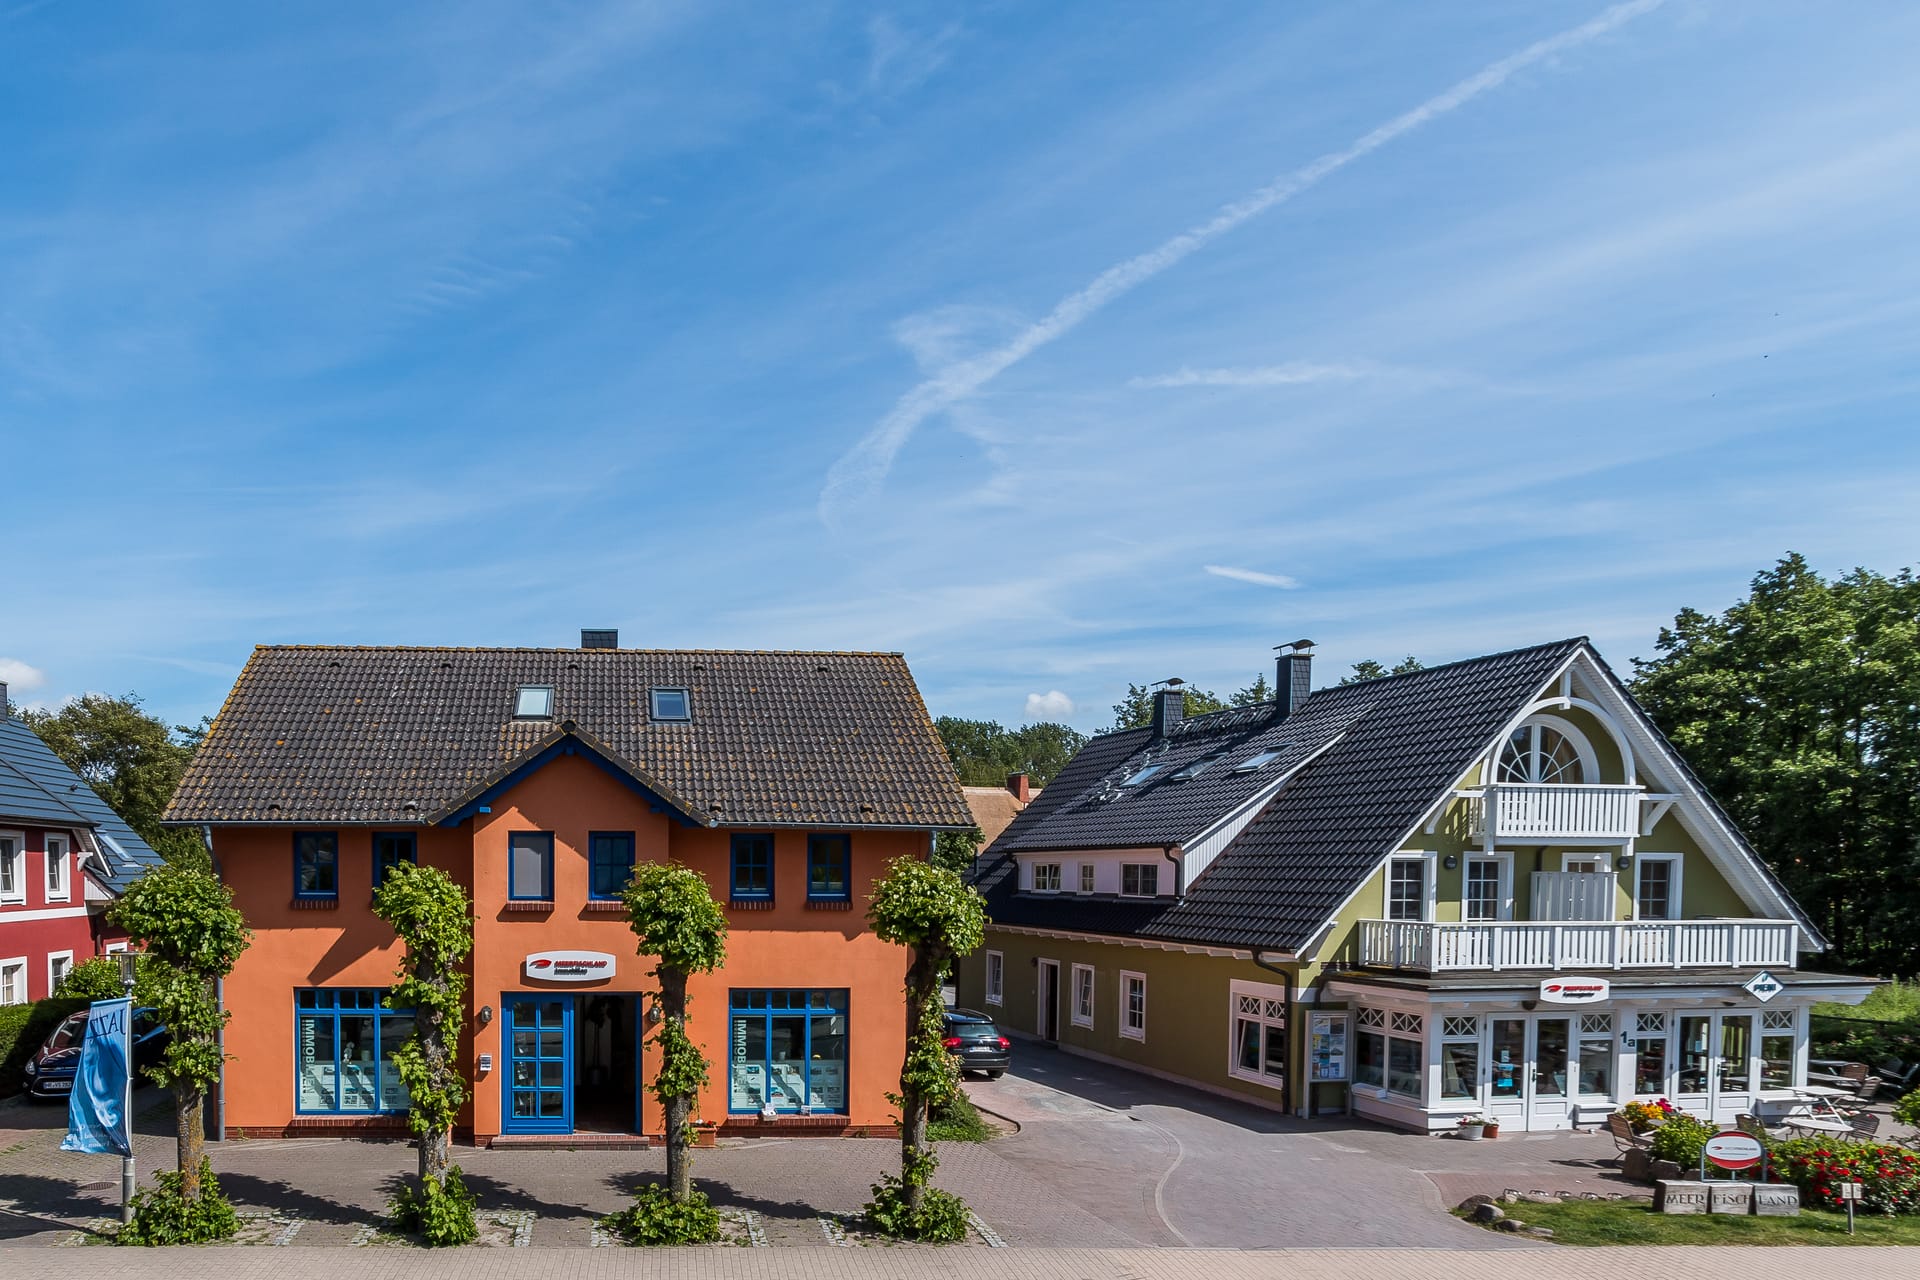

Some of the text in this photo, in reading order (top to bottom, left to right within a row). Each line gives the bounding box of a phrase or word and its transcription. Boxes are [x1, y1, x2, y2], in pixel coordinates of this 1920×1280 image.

[1620, 1030, 1636, 1047] 1a
[1665, 1194, 1705, 1205] MEER
[1758, 1194, 1798, 1206] LAND
